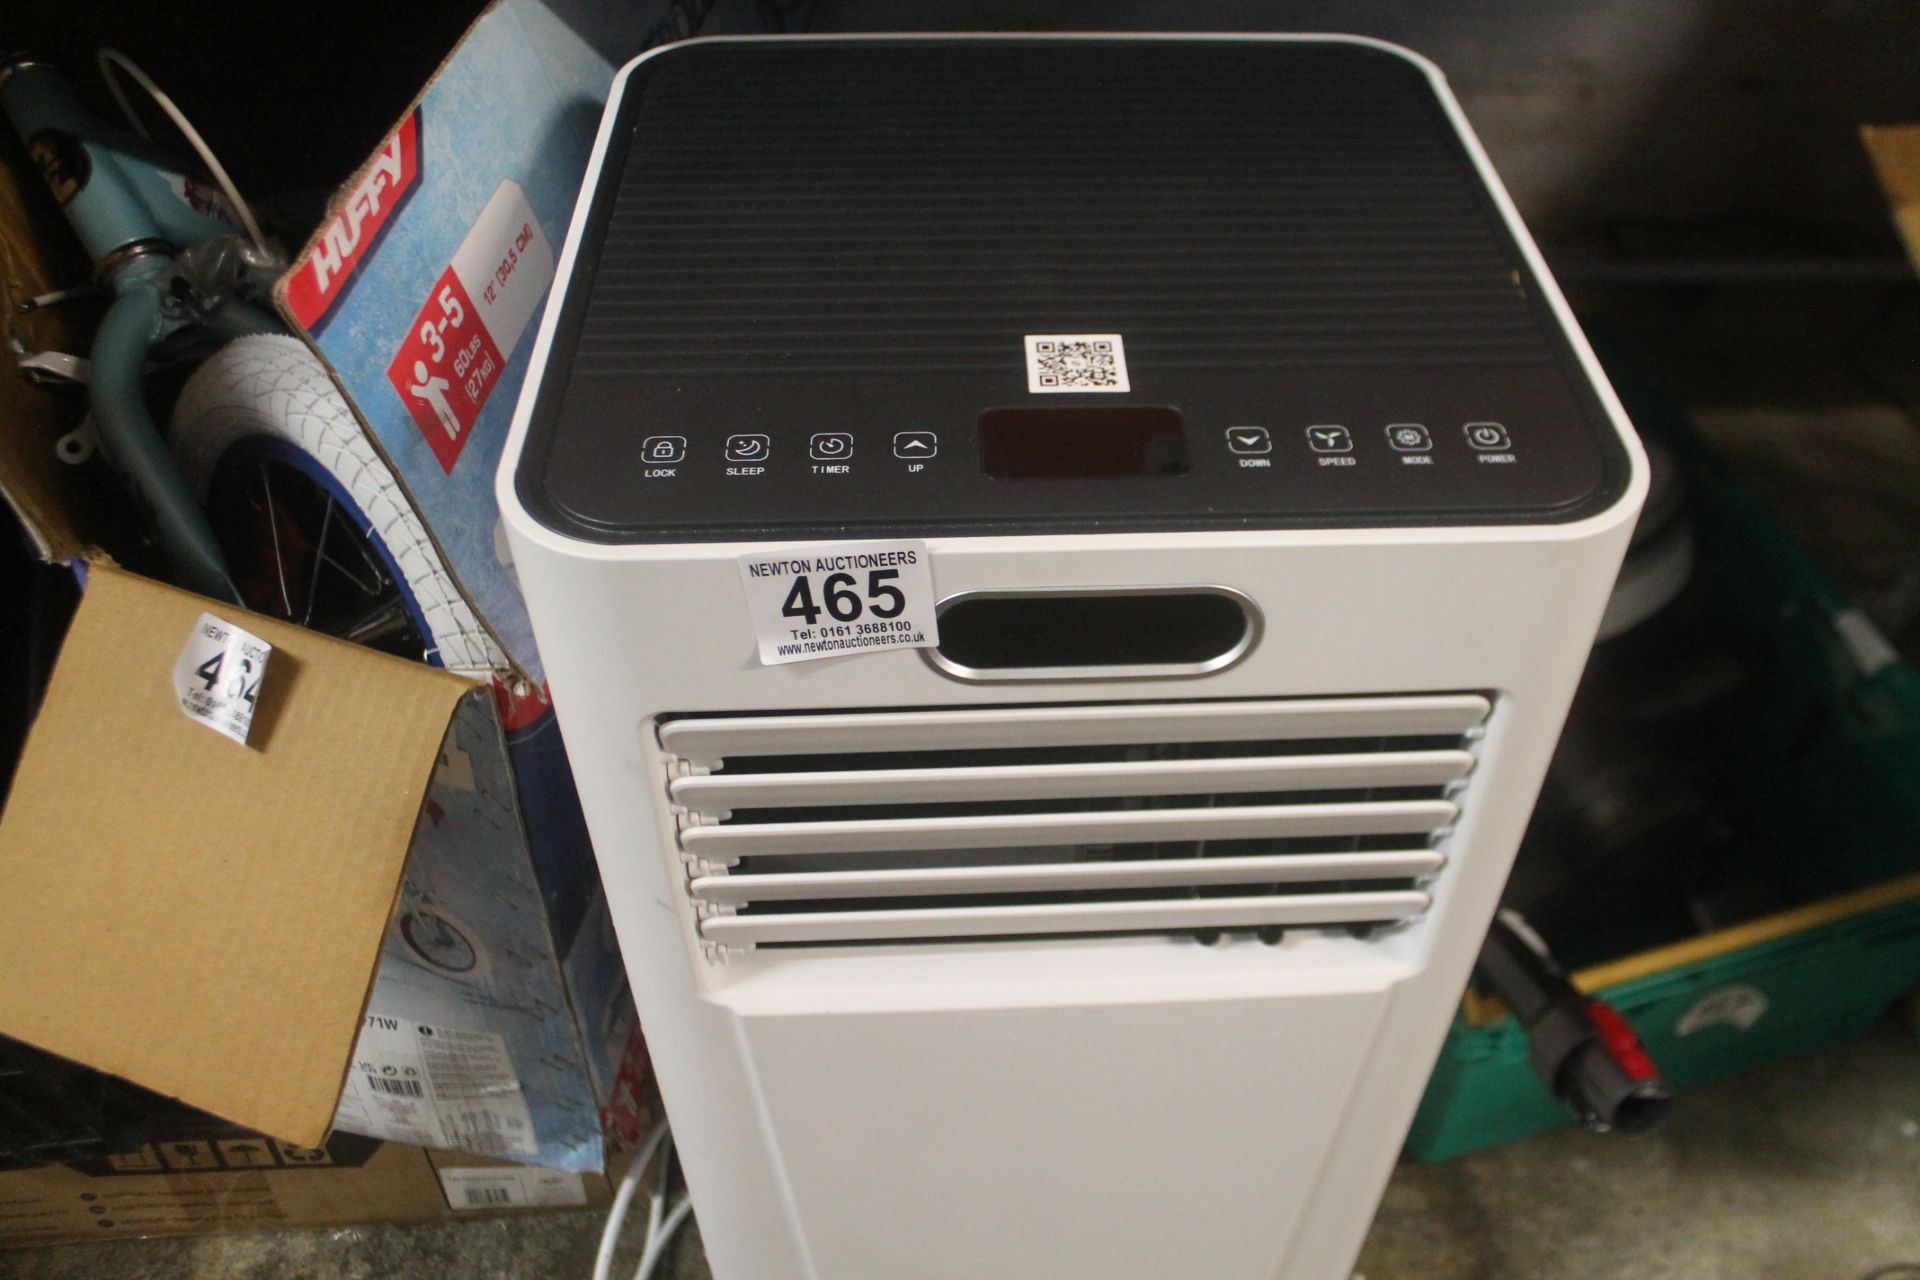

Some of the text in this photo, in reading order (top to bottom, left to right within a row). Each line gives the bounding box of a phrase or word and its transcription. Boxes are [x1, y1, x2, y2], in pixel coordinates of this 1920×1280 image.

[308, 133, 402, 295] HUFFY
[420, 284, 465, 363] 3-5
[1239, 459, 1271, 468] DOWN
[1318, 456, 1356, 466] SPEED
[1402, 455, 1433, 465] MODE
[1478, 454, 1516, 463] POWER
[644, 468, 676, 478] LOCK
[726, 466, 765, 476] SLEEP
[812, 465, 850, 474] TIMER
[908, 463, 924, 473] UP
[749, 550, 917, 577] NEWTON AUCTIONEERS
[781, 568, 906, 625] 465
[202, 622, 231, 643] NEWT
[790, 620, 911, 641] Tel: 0161 3688100
[777, 631, 926, 657] www.newtonauctioneers.co.uk
